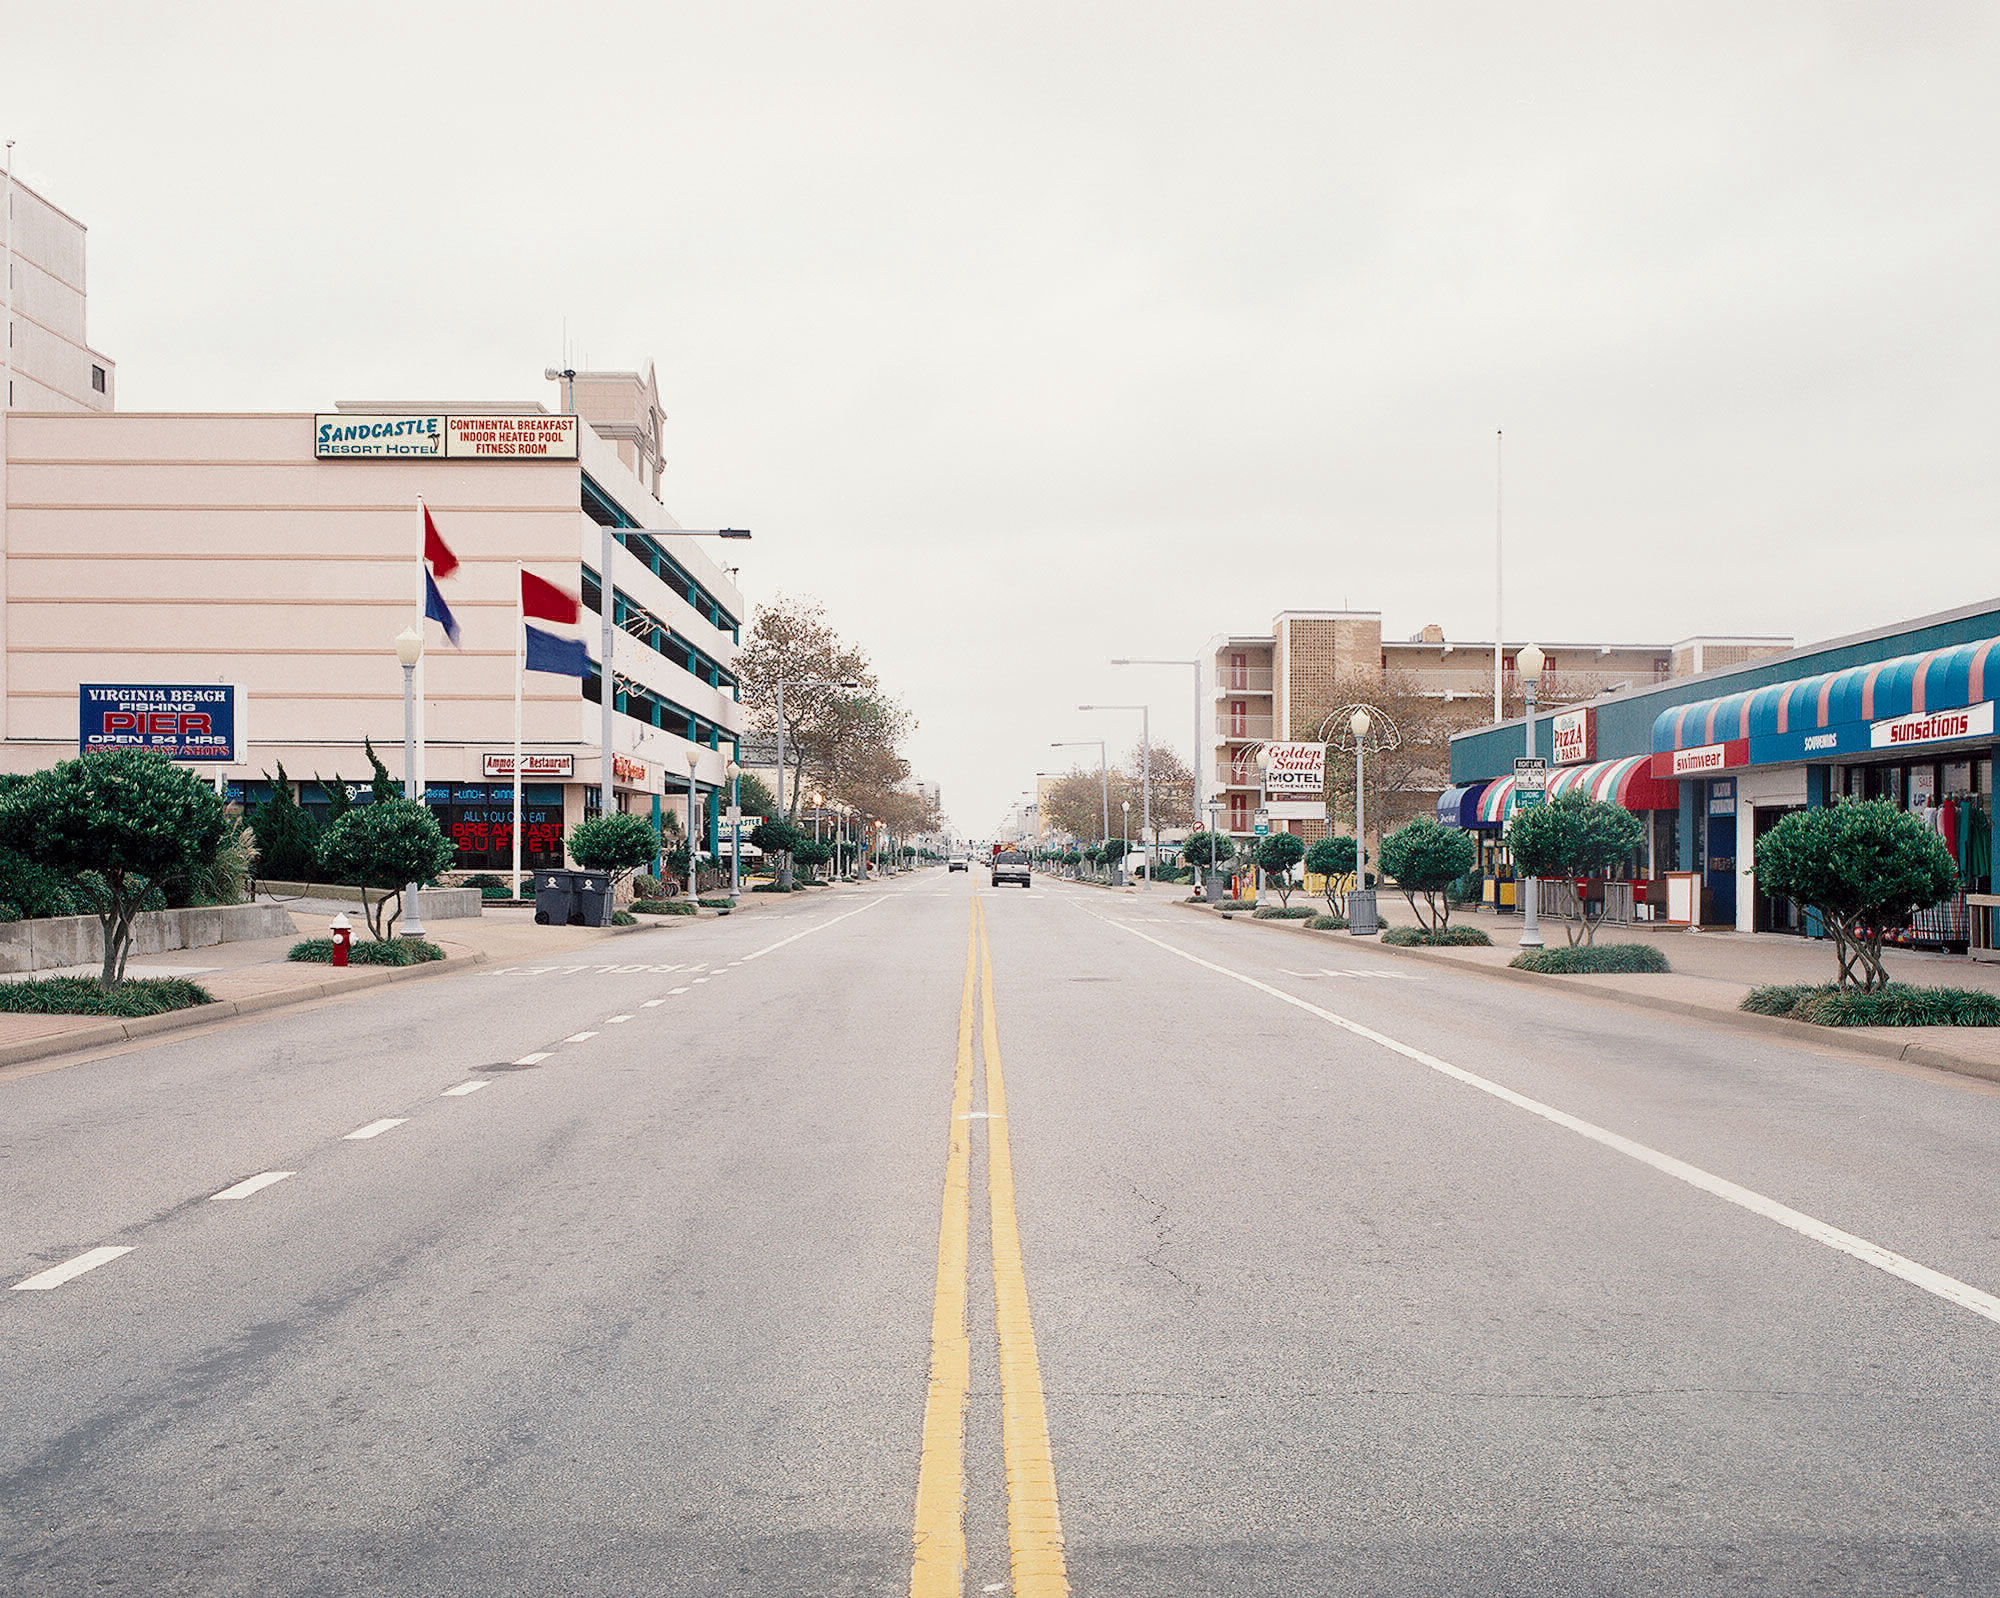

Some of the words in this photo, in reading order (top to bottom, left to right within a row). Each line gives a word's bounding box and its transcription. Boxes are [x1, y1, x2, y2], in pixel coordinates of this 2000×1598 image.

[318, 418, 438, 443] SANDCASTLE
[450, 420, 515, 431] CONTINENTAL
[517, 420, 574, 431] BREAKFAST
[460, 431, 496, 442] INDOOR
[499, 431, 535, 442] HEATED
[538, 431, 564, 442] POOL
[318, 444, 382, 454] RESORT
[386, 444, 438, 454] HOTEL
[476, 443, 516, 454] FITNESS
[518, 443, 547, 454] ROOM
[88, 689, 166, 702] VIRGINIA
[170, 690, 226, 703] BEACH
[119, 702, 196, 712] FISHING
[103, 711, 212, 735] PIER
[1890, 714, 1968, 743] sunsations
[88, 735, 144, 744] OPEN
[151, 735, 178, 745] 24
[185, 735, 227, 745] HRS
[1554, 723, 1582, 748] PIZZA
[1268, 745, 1321, 759] Golden
[1561, 745, 1581, 760] PASTA
[529, 756, 570, 768] Restaurant
[1274, 758, 1322, 771] Sands
[1676, 752, 1721, 771] swimwear
[1268, 773, 1322, 783] MOTEL
[1918, 776, 1933, 788] SALE
[463, 811, 480, 822] ALL
[529, 812, 546, 823] EAT
